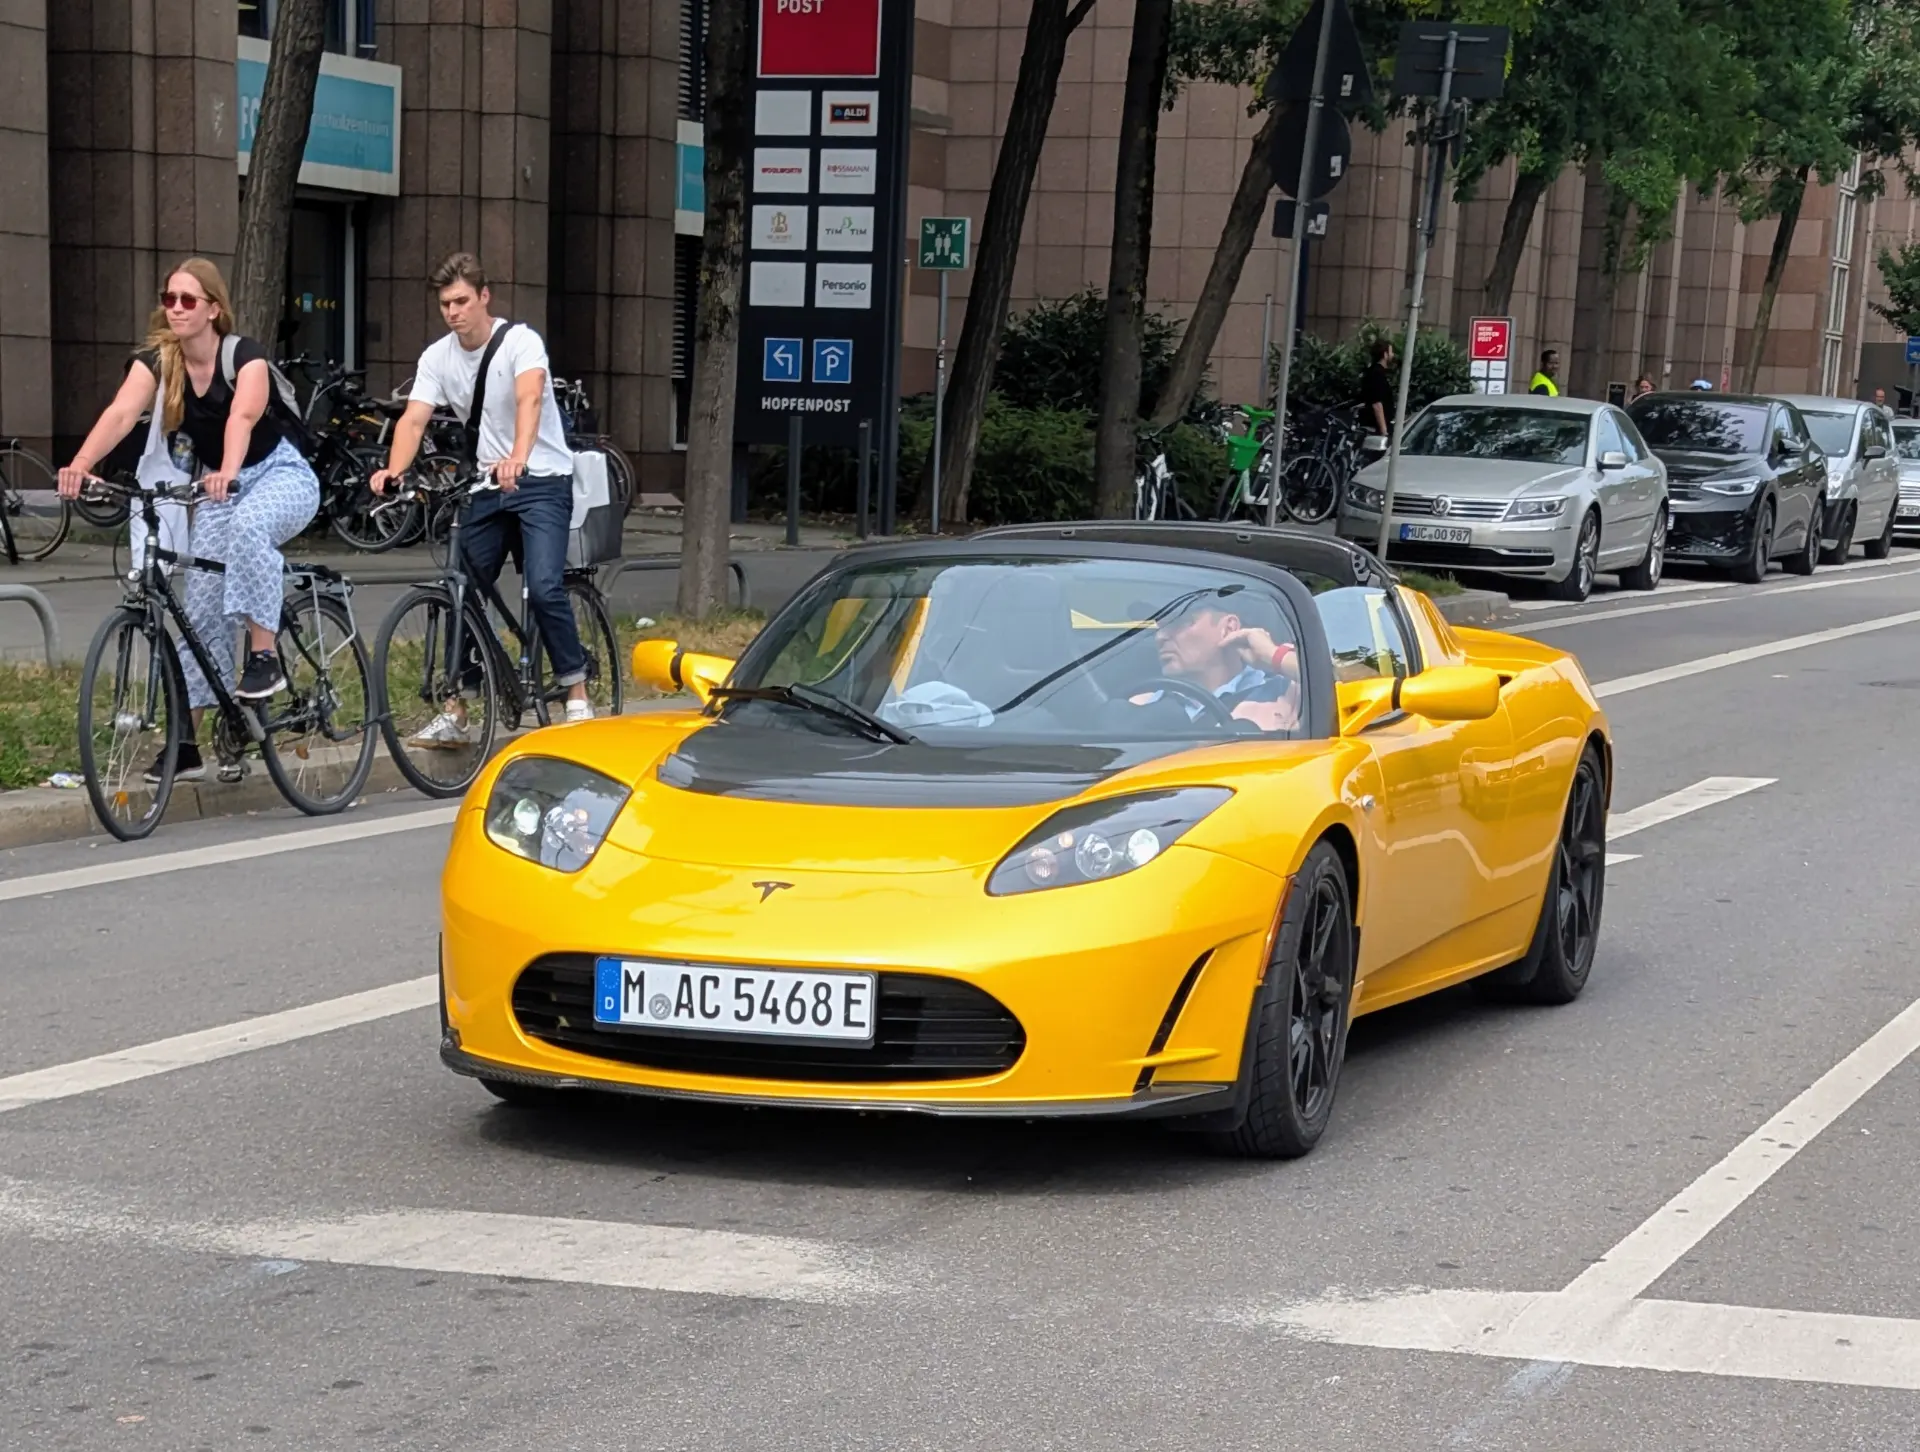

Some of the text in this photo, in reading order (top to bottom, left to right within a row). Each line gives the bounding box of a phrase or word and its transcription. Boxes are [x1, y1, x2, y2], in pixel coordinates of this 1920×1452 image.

[777, 0, 824, 14] POST
[844, 108, 867, 117] ALDI
[827, 165, 870, 173] ROSSMANN
[850, 228, 867, 236] TIM
[822, 279, 867, 291] Personio
[826, 354, 839, 376] P
[761, 397, 851, 412] HOPFENPOST
[1407, 527, 1427, 539] MUC
[1450, 530, 1470, 542] 987
[623, 969, 646, 1014] M
[674, 973, 721, 1020] AC
[604, 996, 615, 1010] D
